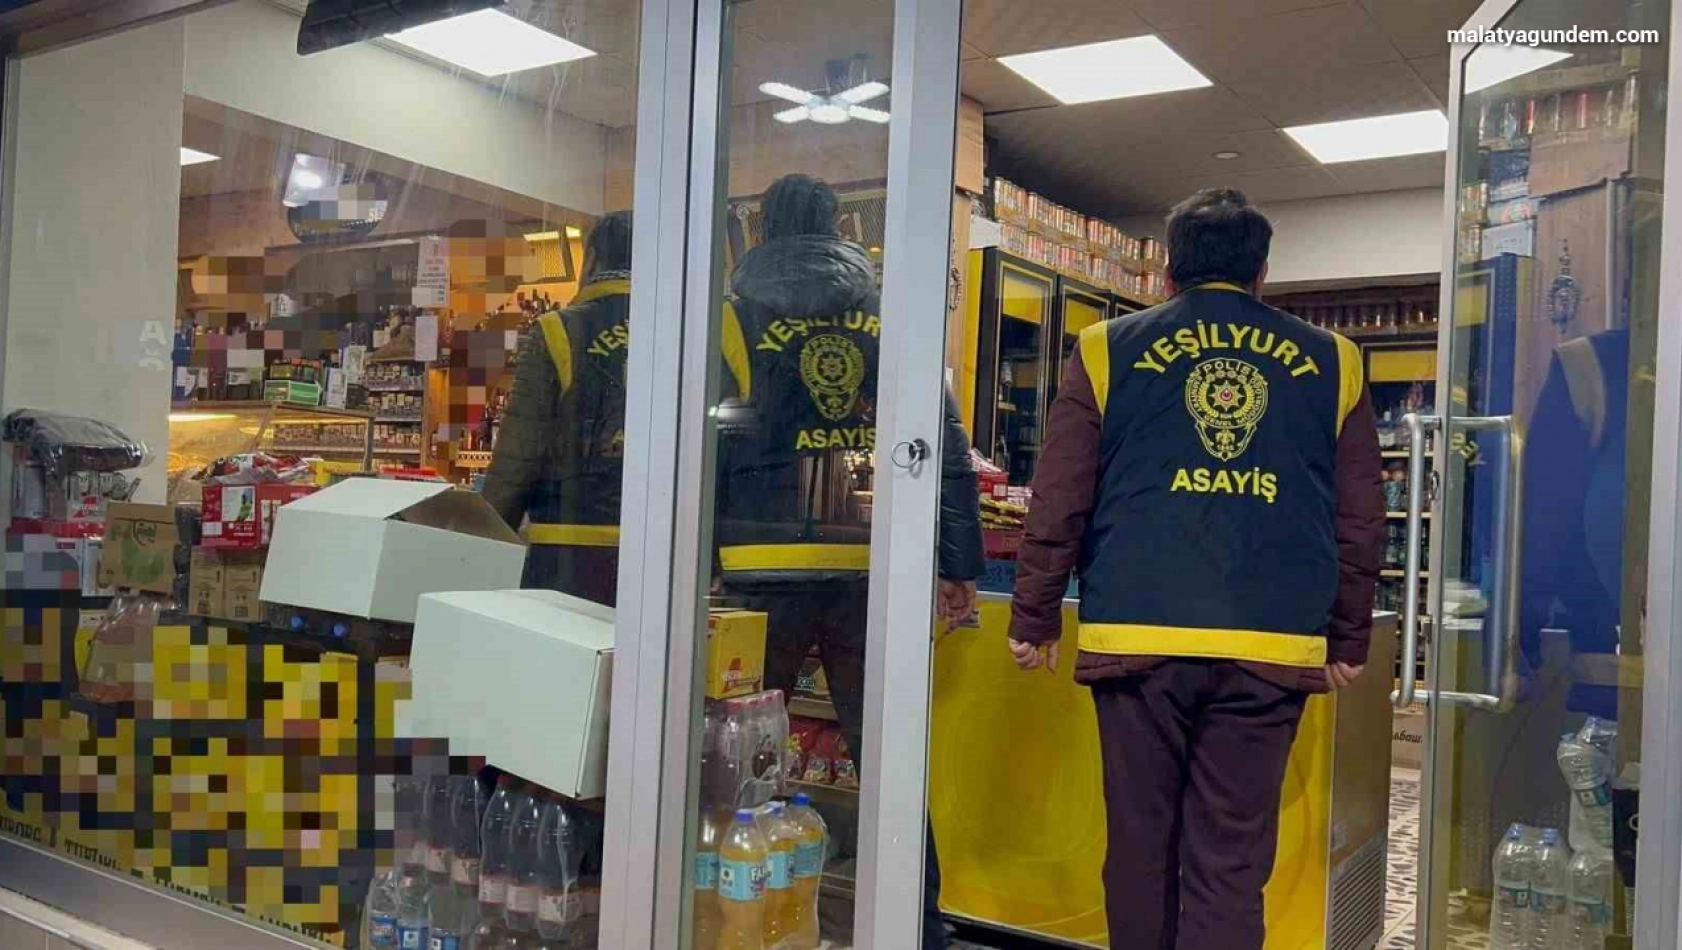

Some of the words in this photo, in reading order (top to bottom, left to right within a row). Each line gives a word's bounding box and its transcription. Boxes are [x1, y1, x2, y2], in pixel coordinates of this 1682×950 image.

[1133, 319, 1320, 377] YEŞİLYURT
[1203, 360, 1251, 374] POLİS
[1170, 466, 1278, 503] ASAYİŞ
